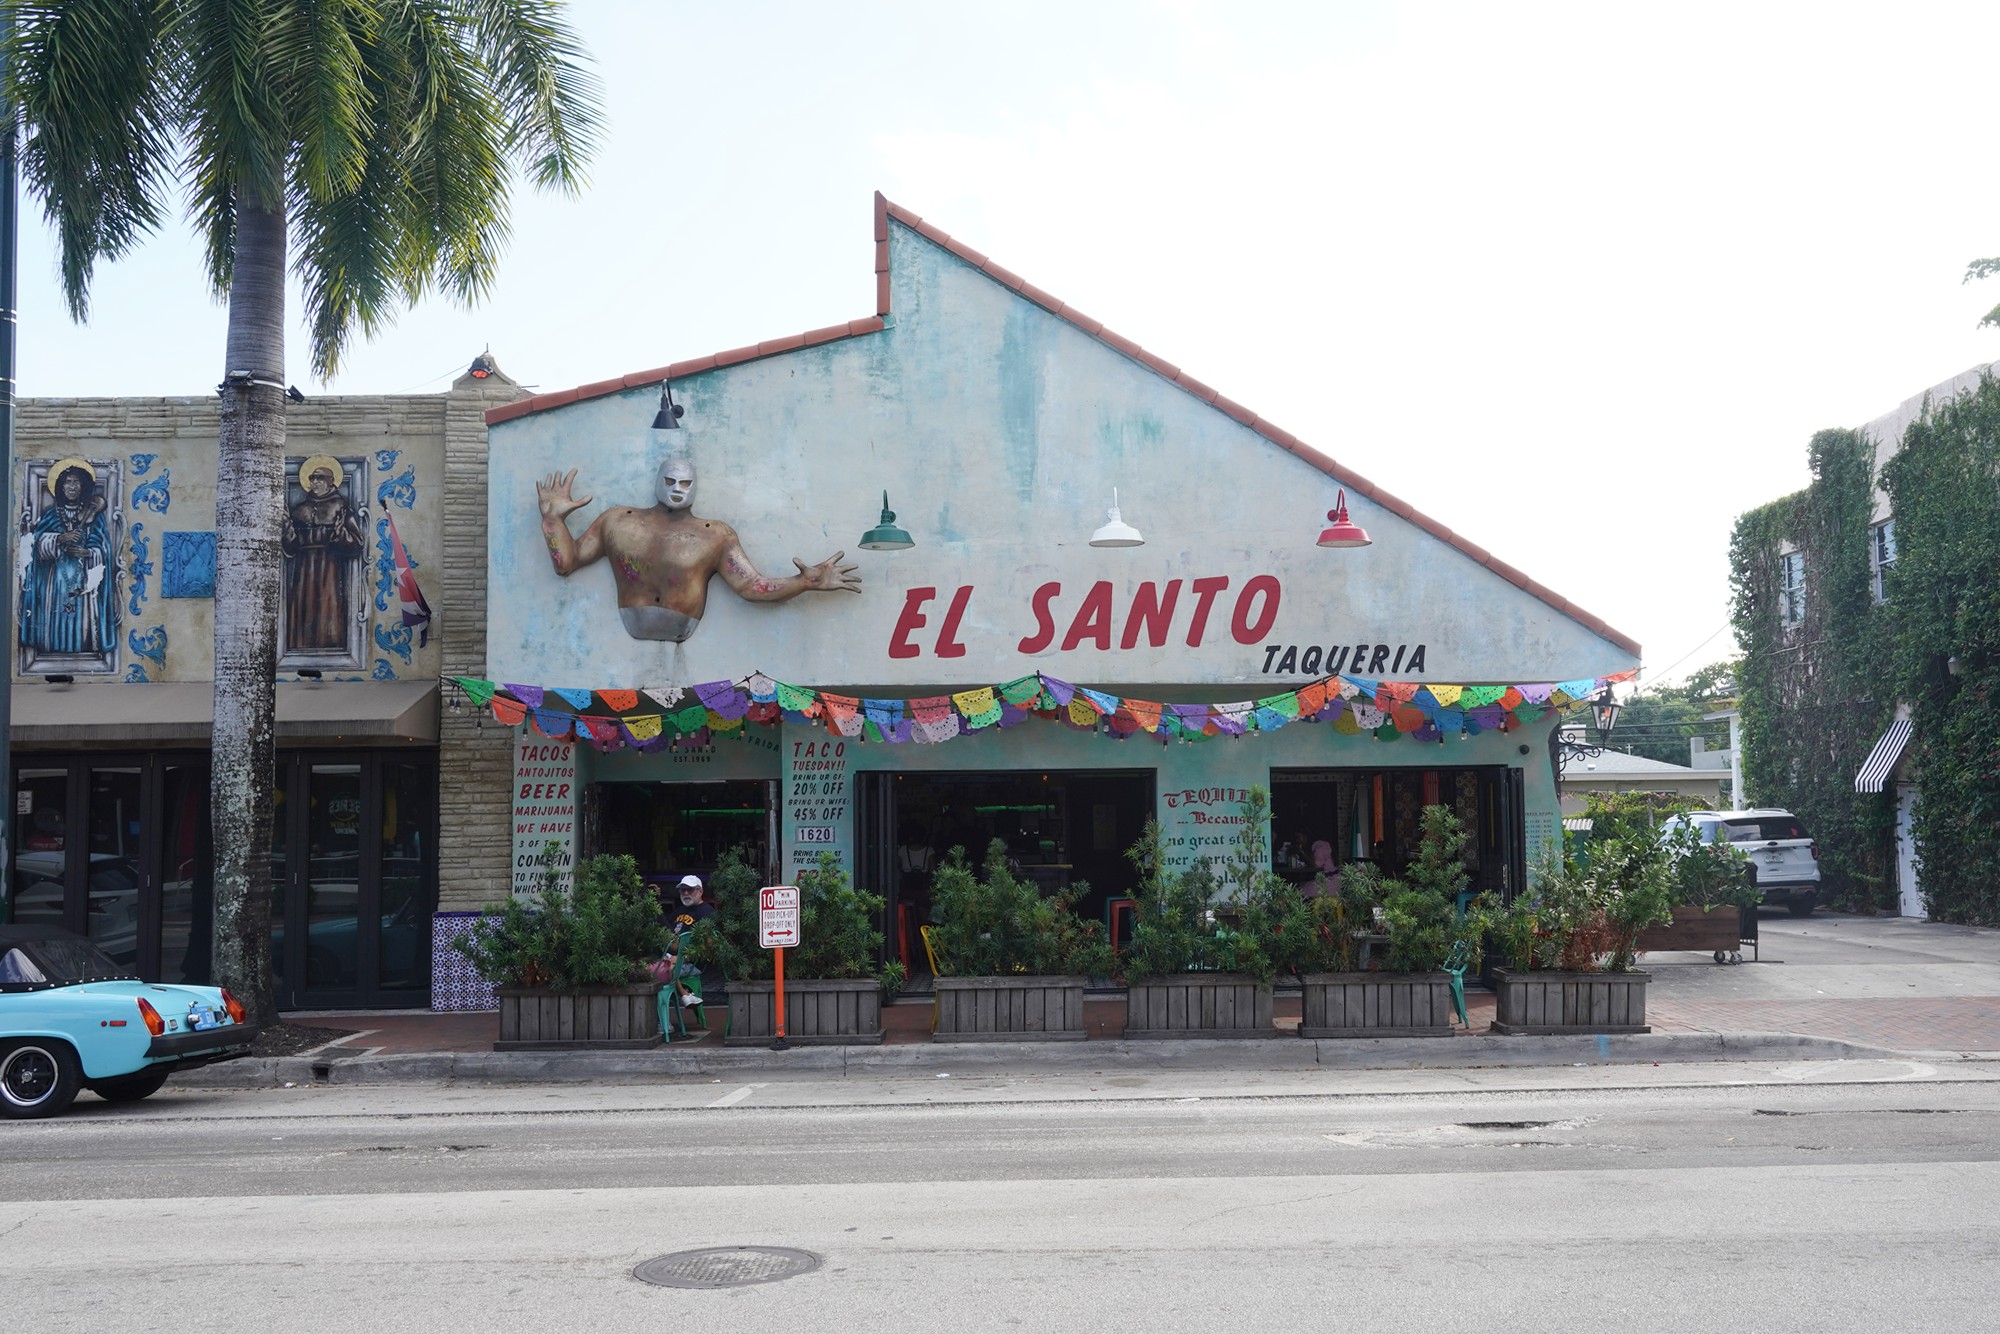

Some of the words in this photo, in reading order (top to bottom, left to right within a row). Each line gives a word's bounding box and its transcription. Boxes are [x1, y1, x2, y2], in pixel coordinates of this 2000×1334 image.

[888, 585, 974, 659] EL
[1017, 575, 1281, 655] SANTO
[1262, 644, 1426, 675] TAQUERIA
[748, 736, 780, 753] FRIDA
[793, 741, 846, 758] TACO
[520, 745, 571, 762] TACOS
[516, 767, 574, 778] ANTOJITOS
[792, 760, 846, 772] TUESDAY!!
[520, 783, 571, 800] BEER
[793, 782, 817, 796] 20%
[822, 782, 844, 796] OFF
[1162, 786, 1254, 809] TEQUIL
[514, 805, 574, 816] MARIJUANA
[793, 808, 817, 821] 45%
[822, 808, 844, 820] OFF
[516, 823, 536, 834] WE
[540, 822, 573, 833] HAVE
[800, 828, 830, 841] 1620
[518, 840, 524, 848] 3
[528, 840, 540, 848] OF
[564, 839, 570, 847] 4
[1190, 835, 1225, 852] great
[558, 854, 572, 866] IN
[515, 872, 526, 882] TO
[556, 872, 572, 881] UT
[762, 893, 774, 908] 10
